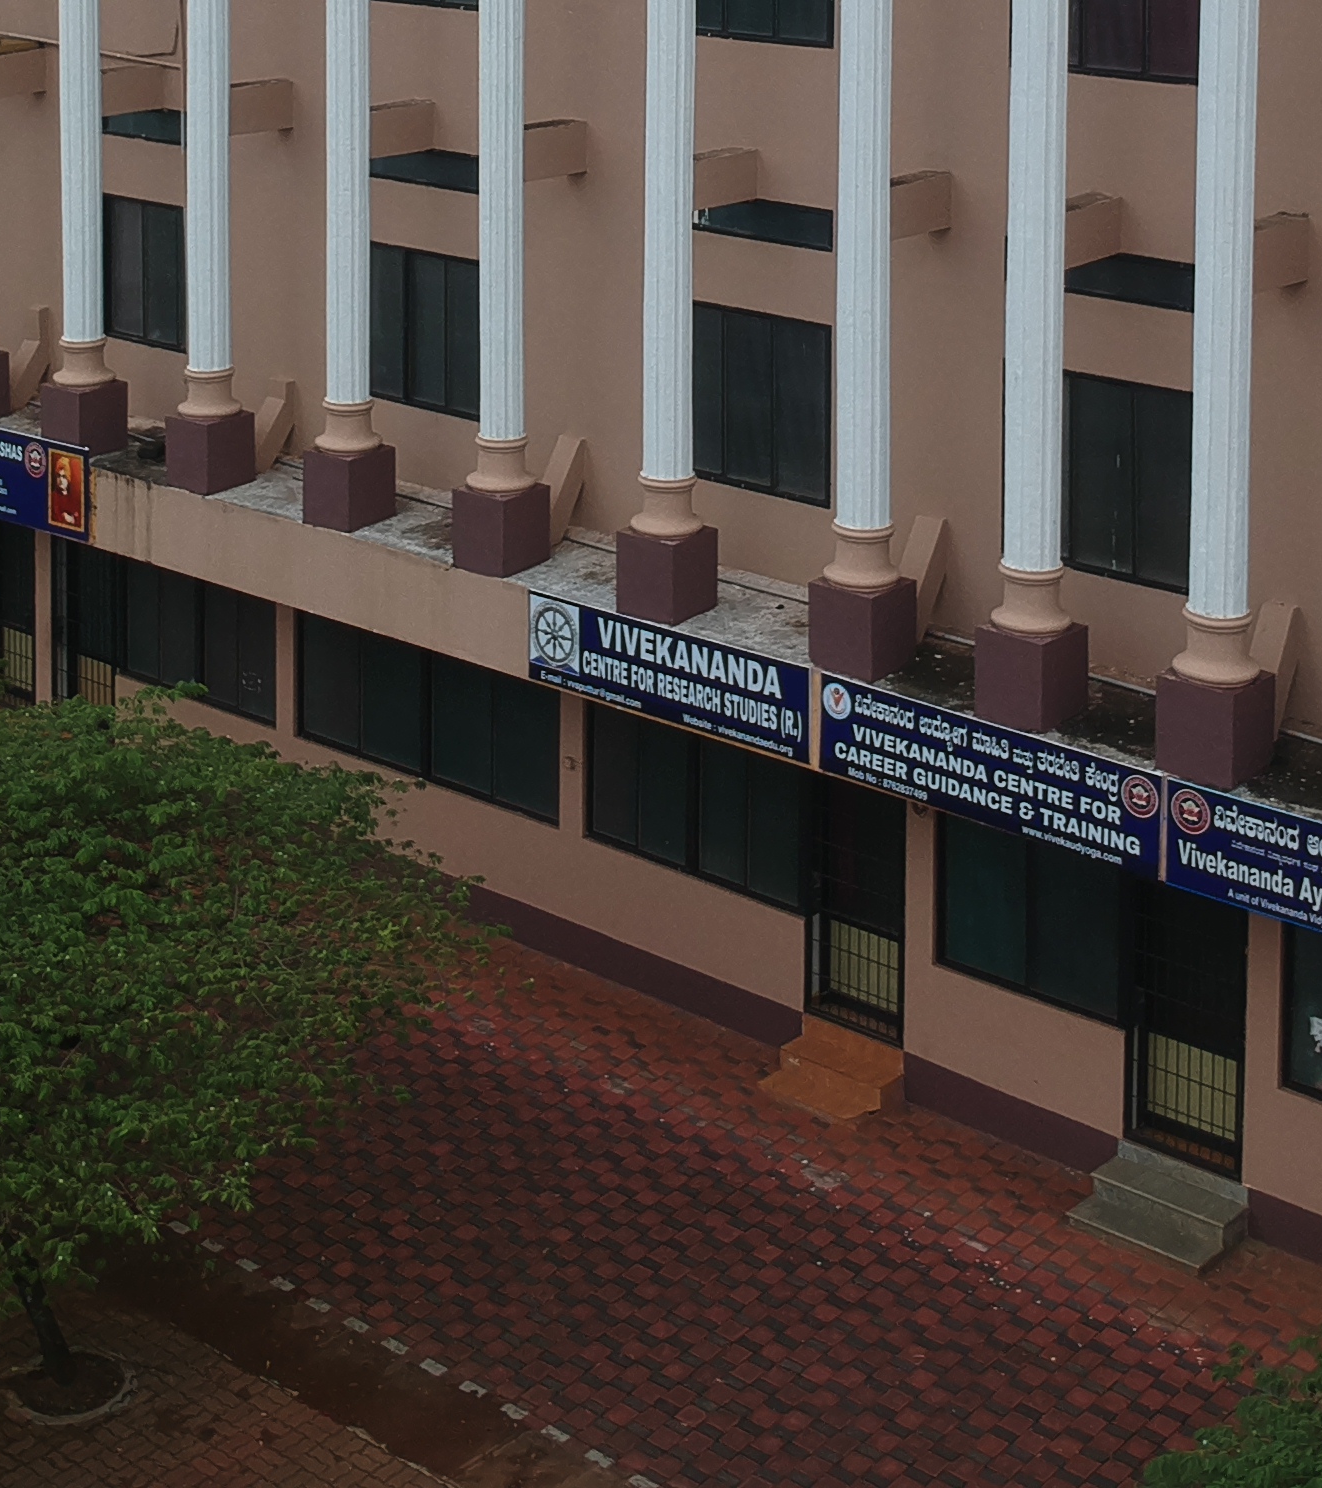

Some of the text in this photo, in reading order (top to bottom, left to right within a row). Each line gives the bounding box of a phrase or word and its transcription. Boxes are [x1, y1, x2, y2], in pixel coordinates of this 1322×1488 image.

[540, 670, 562, 685] E-mail
[597, 617, 782, 699] VIVEKANANDA
[582, 650, 803, 743] CENTRE FOR RESEARCH STUDIES (R.)
[682, 713, 712, 731] Website
[718, 724, 794, 757] vivekanandaedu.org
[854, 694, 915, 730] ವಿವೇಕಾನಂದ
[919, 715, 968, 751] ಉದ್ಯೋಗ
[972, 729, 1009, 760] ಮಾಹಿತಿ
[1012, 747, 1034, 773] ಮತ್ತು
[1036, 750, 1080, 782] ತರಬೇತಿ
[1085, 761, 1119, 802] ಕೇಂದ್ರ
[834, 742, 908, 781] CAREER
[912, 767, 1013, 815] GUIDANCE
[1019, 802, 1035, 820] &
[1039, 807, 1141, 856] TRAINING
[847, 766, 862, 779] Mob
[864, 771, 877, 784] No
[852, 723, 987, 784] VIVEKANANDA
[993, 770, 1074, 809] CENTRE
[1079, 795, 1121, 825] FOR
[1021, 824, 1123, 866] www.vivekaudyoga.com
[1213, 805, 1299, 851] ವಿವೇಕಾನಂದ
[1177, 839, 1293, 898] Vivekananda
[1227, 888, 1234, 897] A
[1234, 891, 1250, 904] unit
[1251, 896, 1259, 906] of
[1259, 898, 1308, 923] Vivekananda
